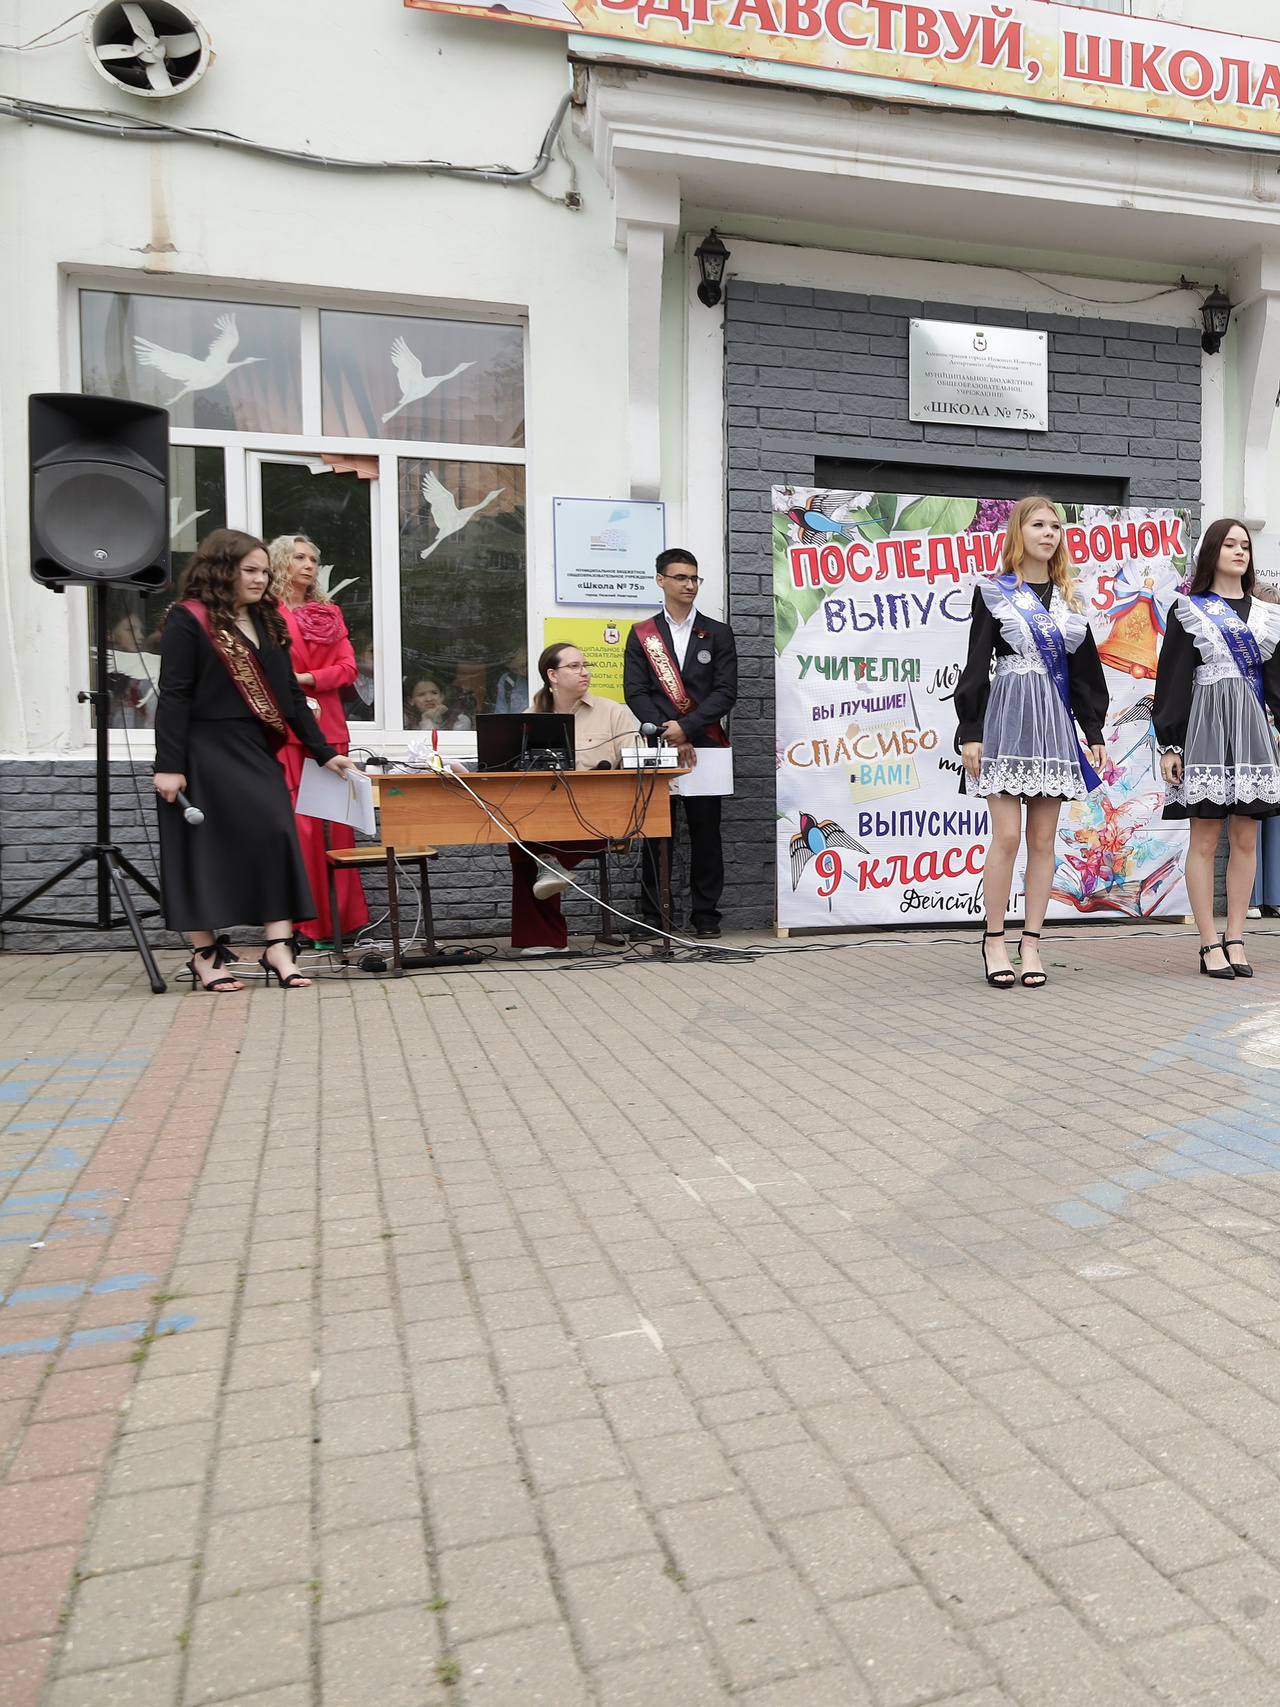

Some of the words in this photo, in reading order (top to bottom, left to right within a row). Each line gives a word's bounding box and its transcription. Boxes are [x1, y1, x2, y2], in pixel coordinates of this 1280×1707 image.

[924, 371, 989, 383] МУНИЦИПАЛЬНОЕ
[989, 377, 1035, 387] БЮДЖЕТНОЕ
[937, 380, 1022, 393] ОБЩЕОБРАЗОВАТЕЛЬНОЕ
[956, 389, 1004, 398] УЧРЕЖДЕНИЕ
[924, 401, 990, 417] «ШКОЛА
[994, 406, 1012, 418] №
[1015, 408, 1036, 420] 75»
[790, 533, 1006, 587] ПОСЛЕДНИ
[1064, 520, 1184, 564] ВОНОК
[577, 582, 614, 590] «Школа
[629, 583, 645, 591] 75»
[824, 589, 972, 633] ВЫПУС
[797, 655, 921, 683] УЧИТЕЛЯ!
[813, 703, 834, 721] ВЫ
[839, 693, 906, 717] ЛУЧШИЕ!
[788, 730, 938, 767] СПАСИБО
[860, 764, 910, 786] ВАМ!
[859, 810, 988, 837] ВЫПУСКНИ
[815, 850, 842, 897] 9
[858, 844, 985, 892] класс
